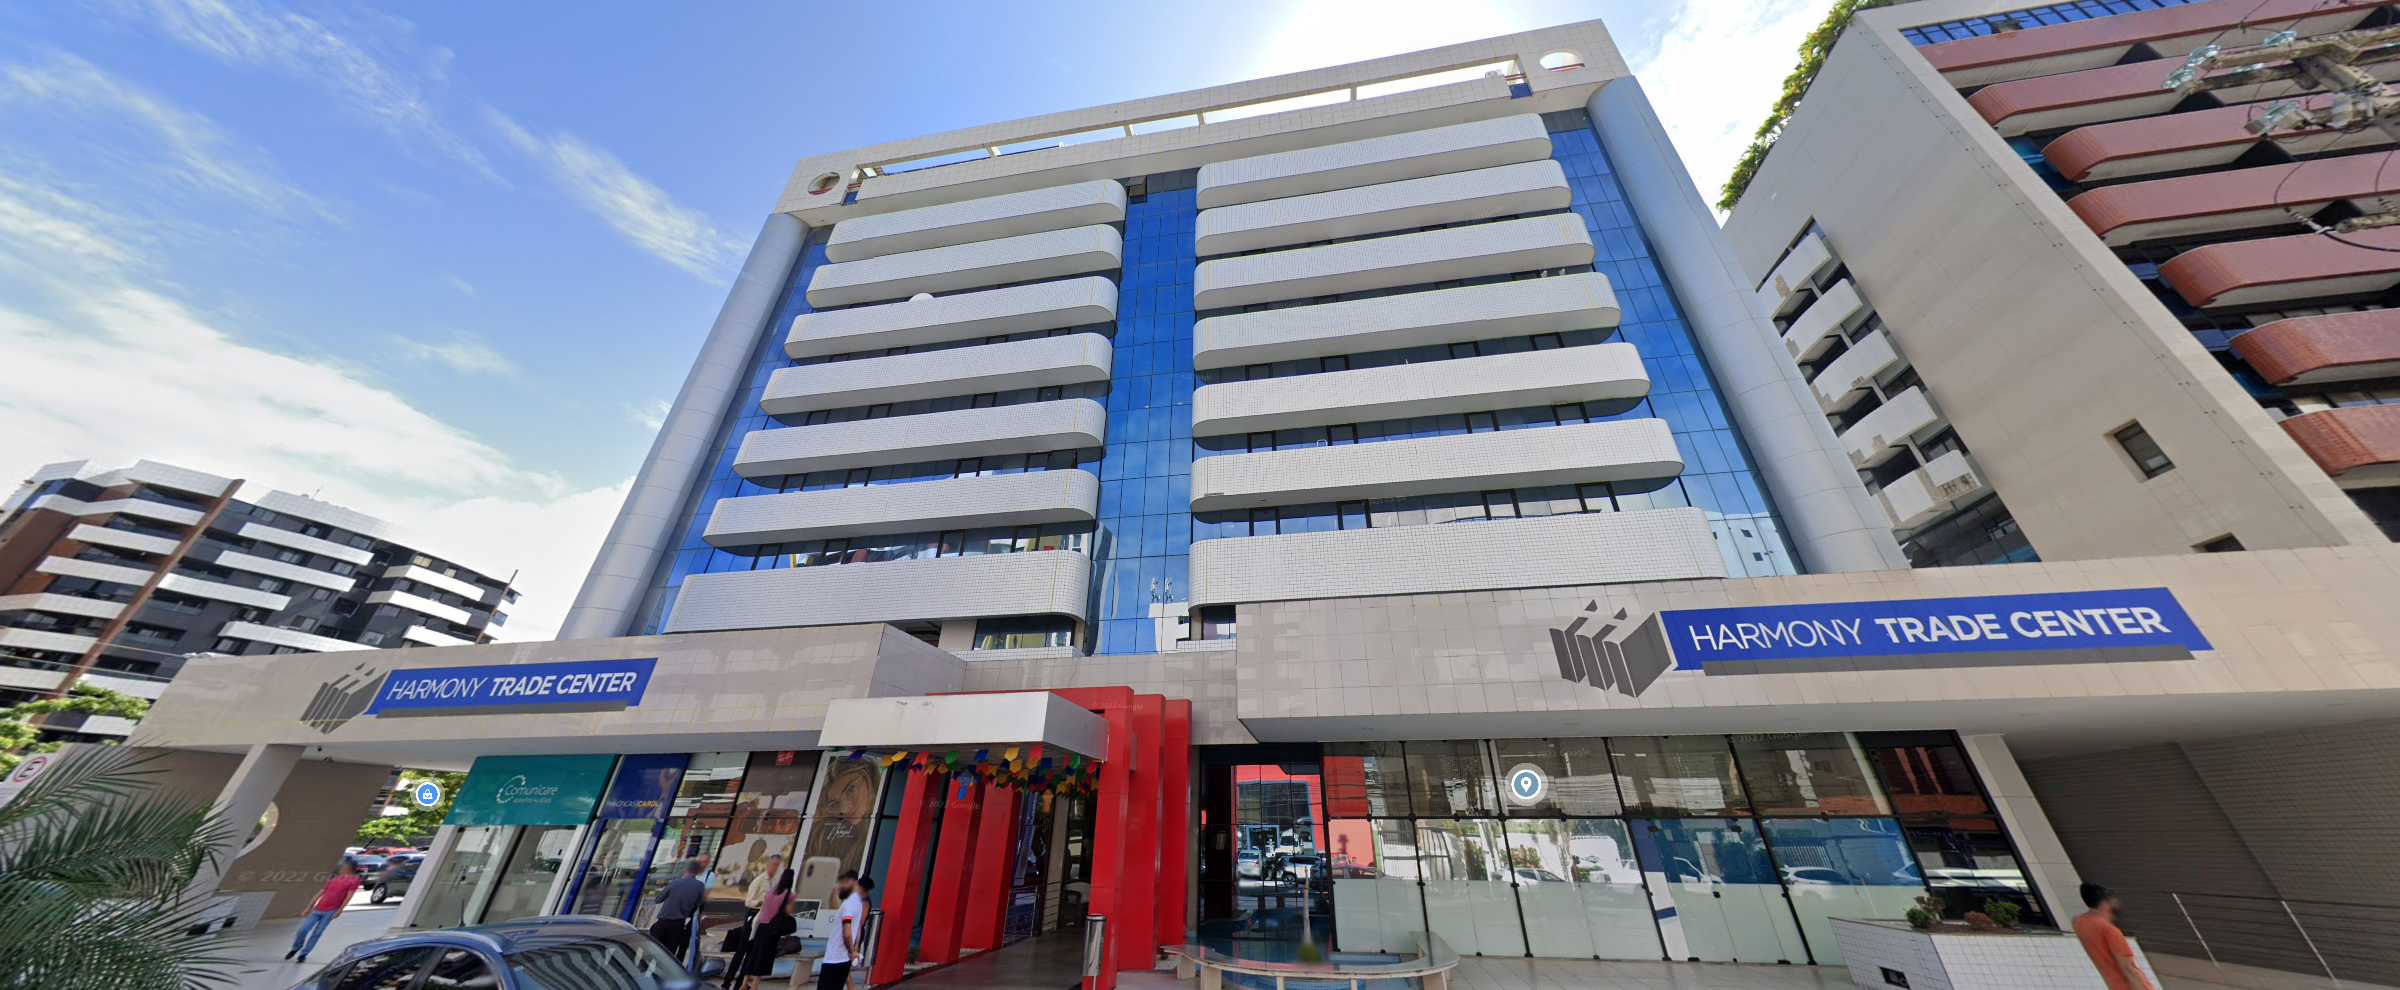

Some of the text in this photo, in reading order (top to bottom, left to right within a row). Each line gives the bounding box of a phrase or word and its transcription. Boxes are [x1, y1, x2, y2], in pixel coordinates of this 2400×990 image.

[1688, 606, 2172, 651] HARMONY TRADE CENTER
[386, 672, 638, 700] HARMONY TRADE CENTER
[18, 760, 42, 778] E
[504, 784, 558, 796] Comunicare
